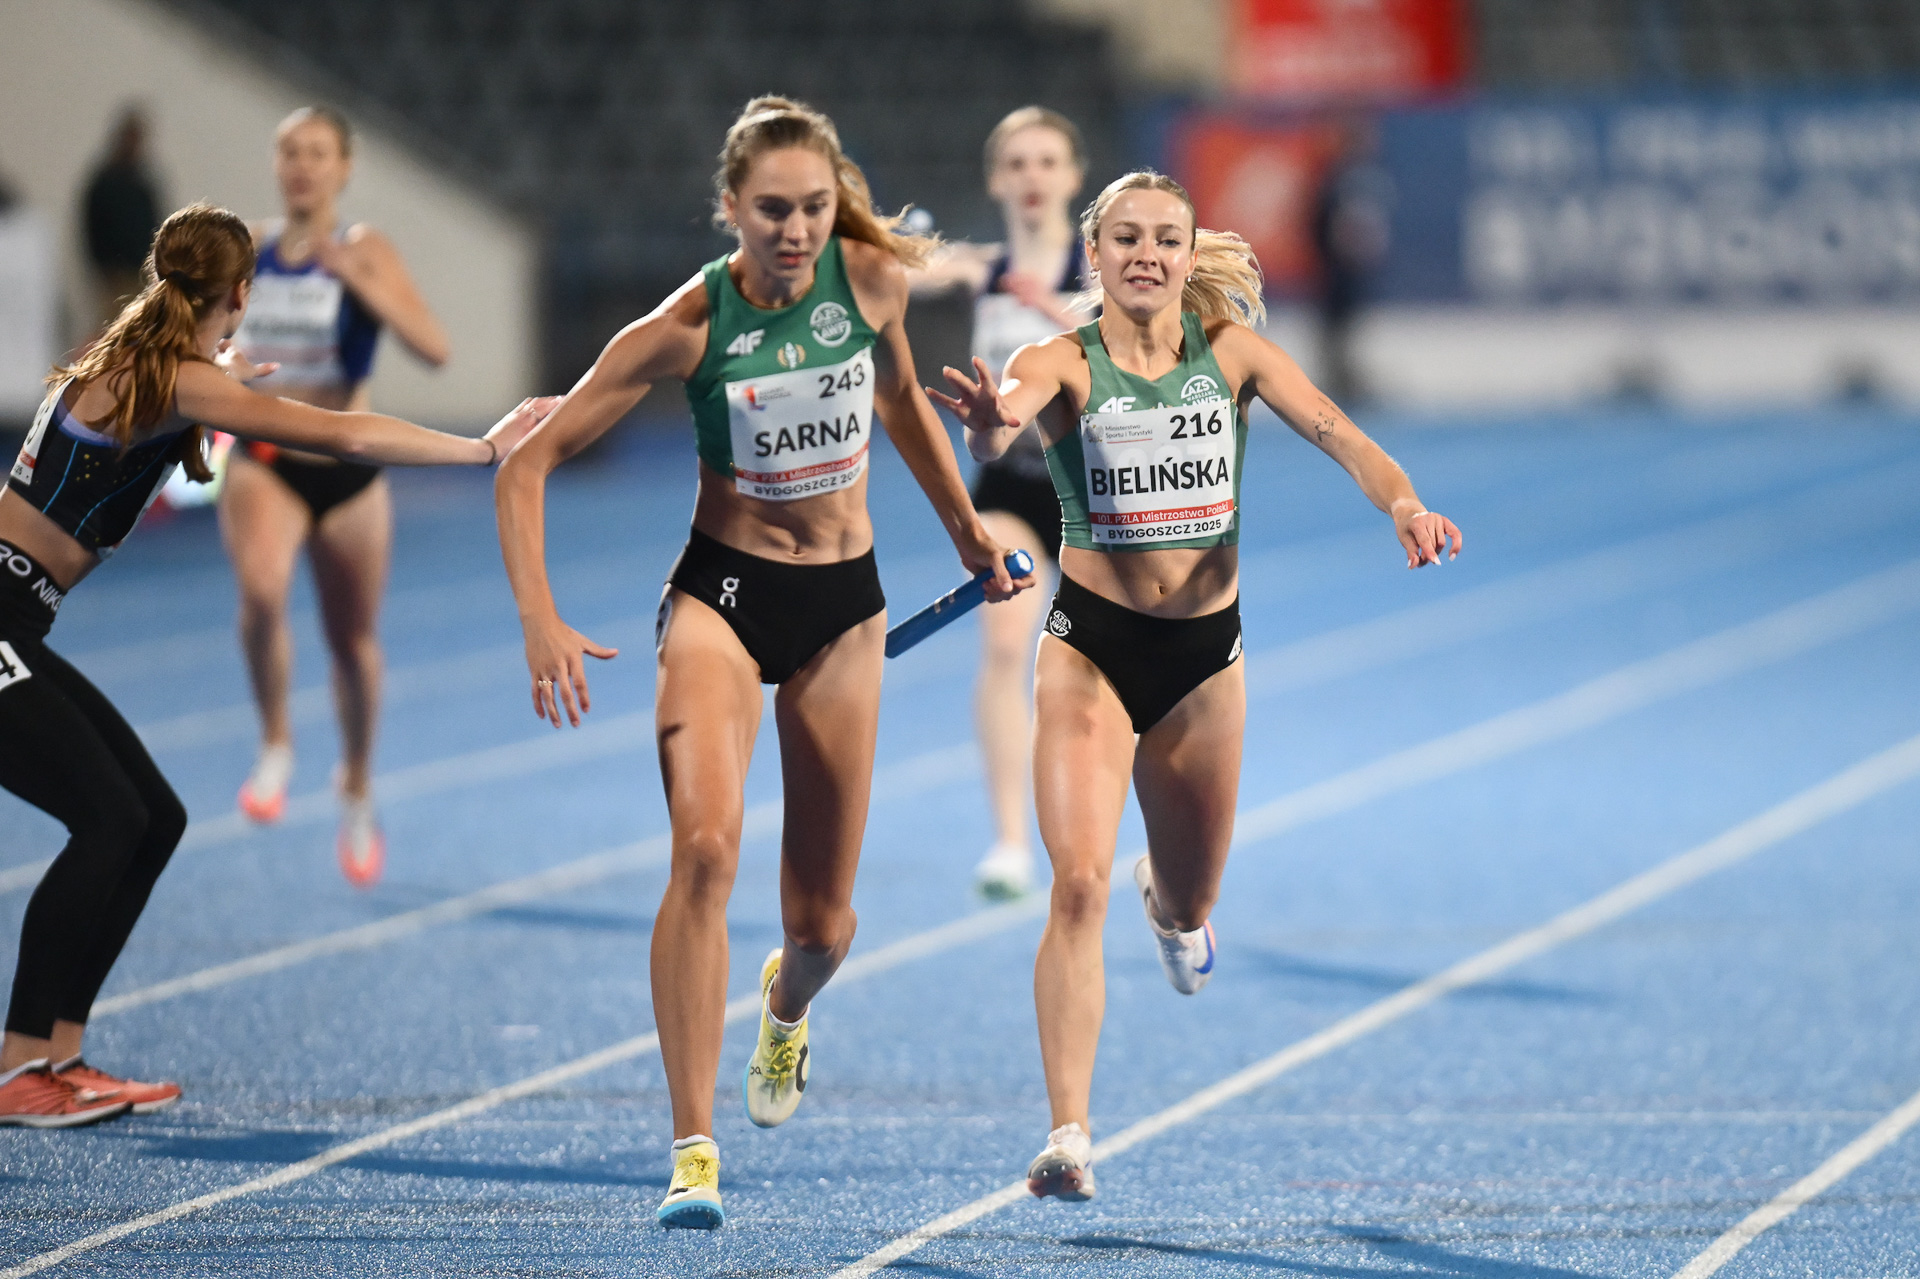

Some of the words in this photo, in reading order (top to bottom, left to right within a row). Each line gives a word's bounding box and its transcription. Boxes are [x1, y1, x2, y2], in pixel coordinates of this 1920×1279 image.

[726, 329, 766, 356] 4F
[818, 363, 866, 399] 243
[1188, 379, 1210, 396] AZS
[1097, 396, 1137, 413] 4F
[754, 412, 860, 458] SARNA
[1105, 424, 1141, 432] Ministerstwo
[1128, 429, 1153, 438] Turystyki
[1169, 410, 1222, 440] 216
[754, 476, 838, 496] BYDGOSZCZ
[1090, 456, 1229, 496] BIELIŃSKA
[1097, 514, 1113, 524] 101.
[1115, 514, 1140, 524] PZLA
[1142, 509, 1205, 523] Mistrzostwa
[1207, 502, 1229, 515] Polski
[1108, 524, 1191, 539] BYDGOSZCZ
[1194, 519, 1222, 532] 2025
[31, 577, 64, 612] NIK
